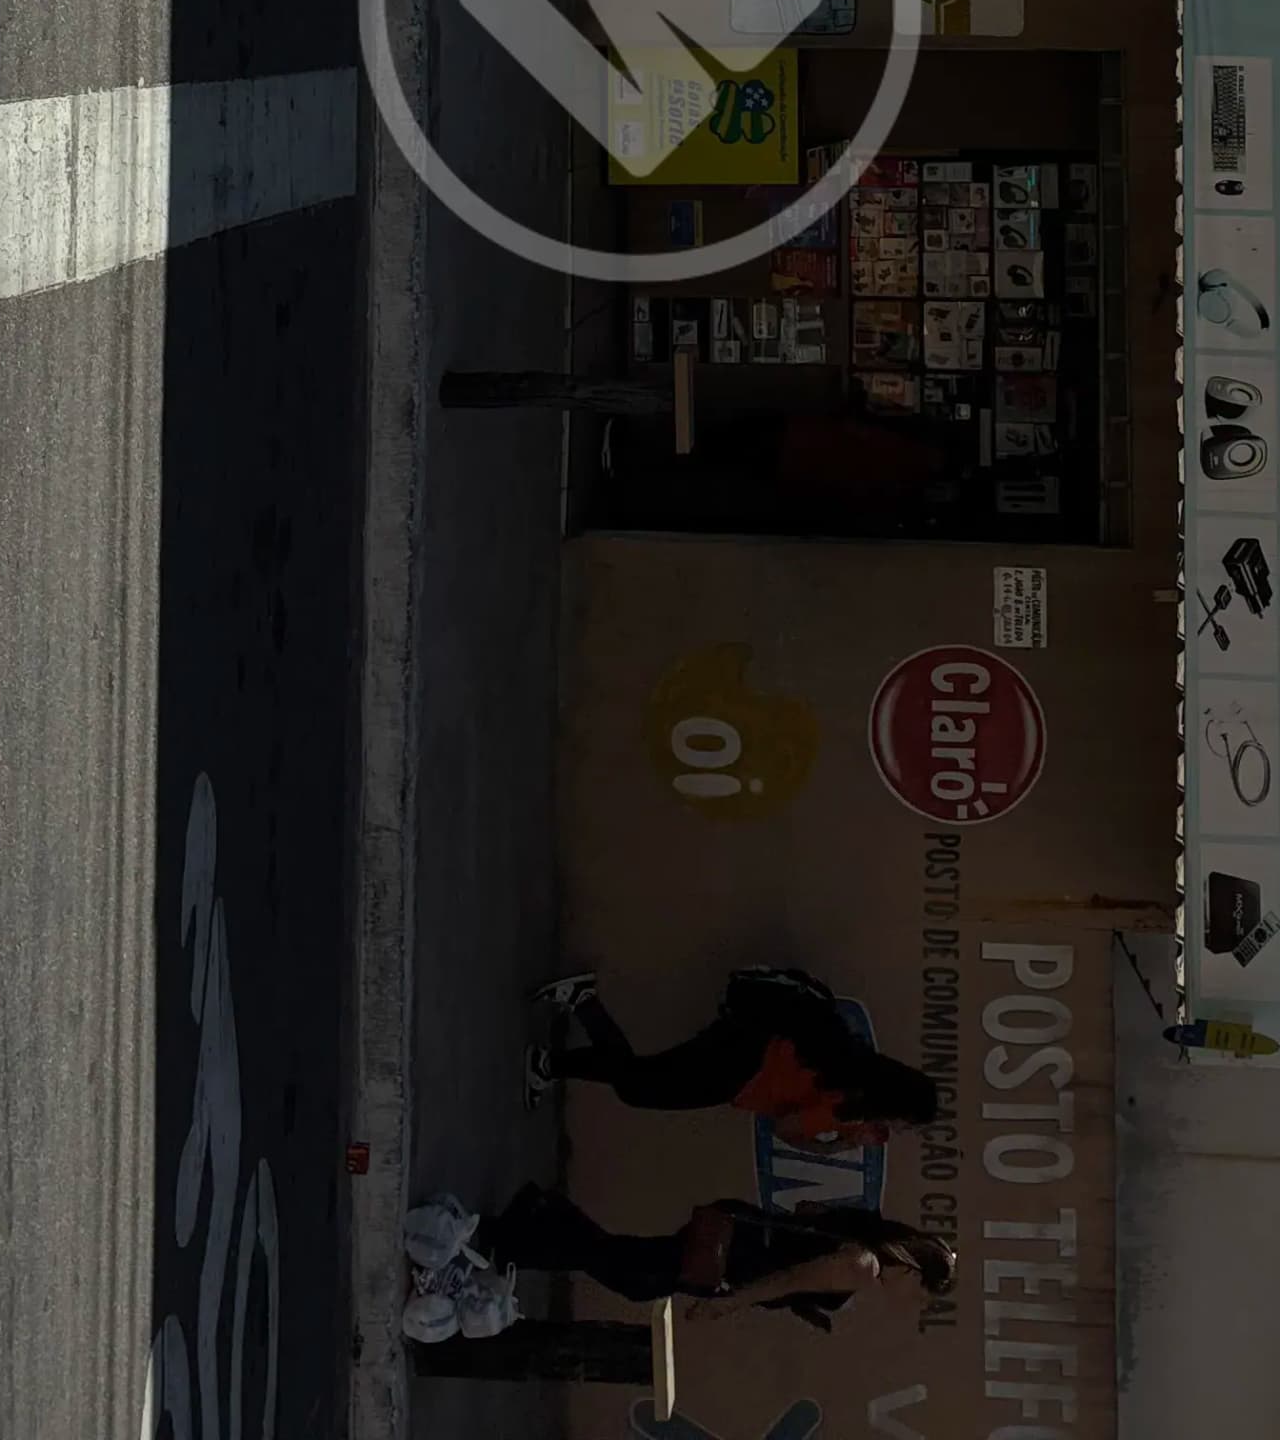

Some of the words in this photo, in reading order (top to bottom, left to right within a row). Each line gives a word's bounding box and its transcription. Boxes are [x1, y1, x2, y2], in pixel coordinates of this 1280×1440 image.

[670, 716, 766, 801] oi
[929, 661, 994, 804] Claro
[922, 832, 961, 917] POSTO
[922, 928, 960, 961] DE
[919, 969, 966, 1182] COMUNICAÇÃO
[979, 940, 1076, 1185] POSTO
[918, 1193, 959, 1334] CEAL
